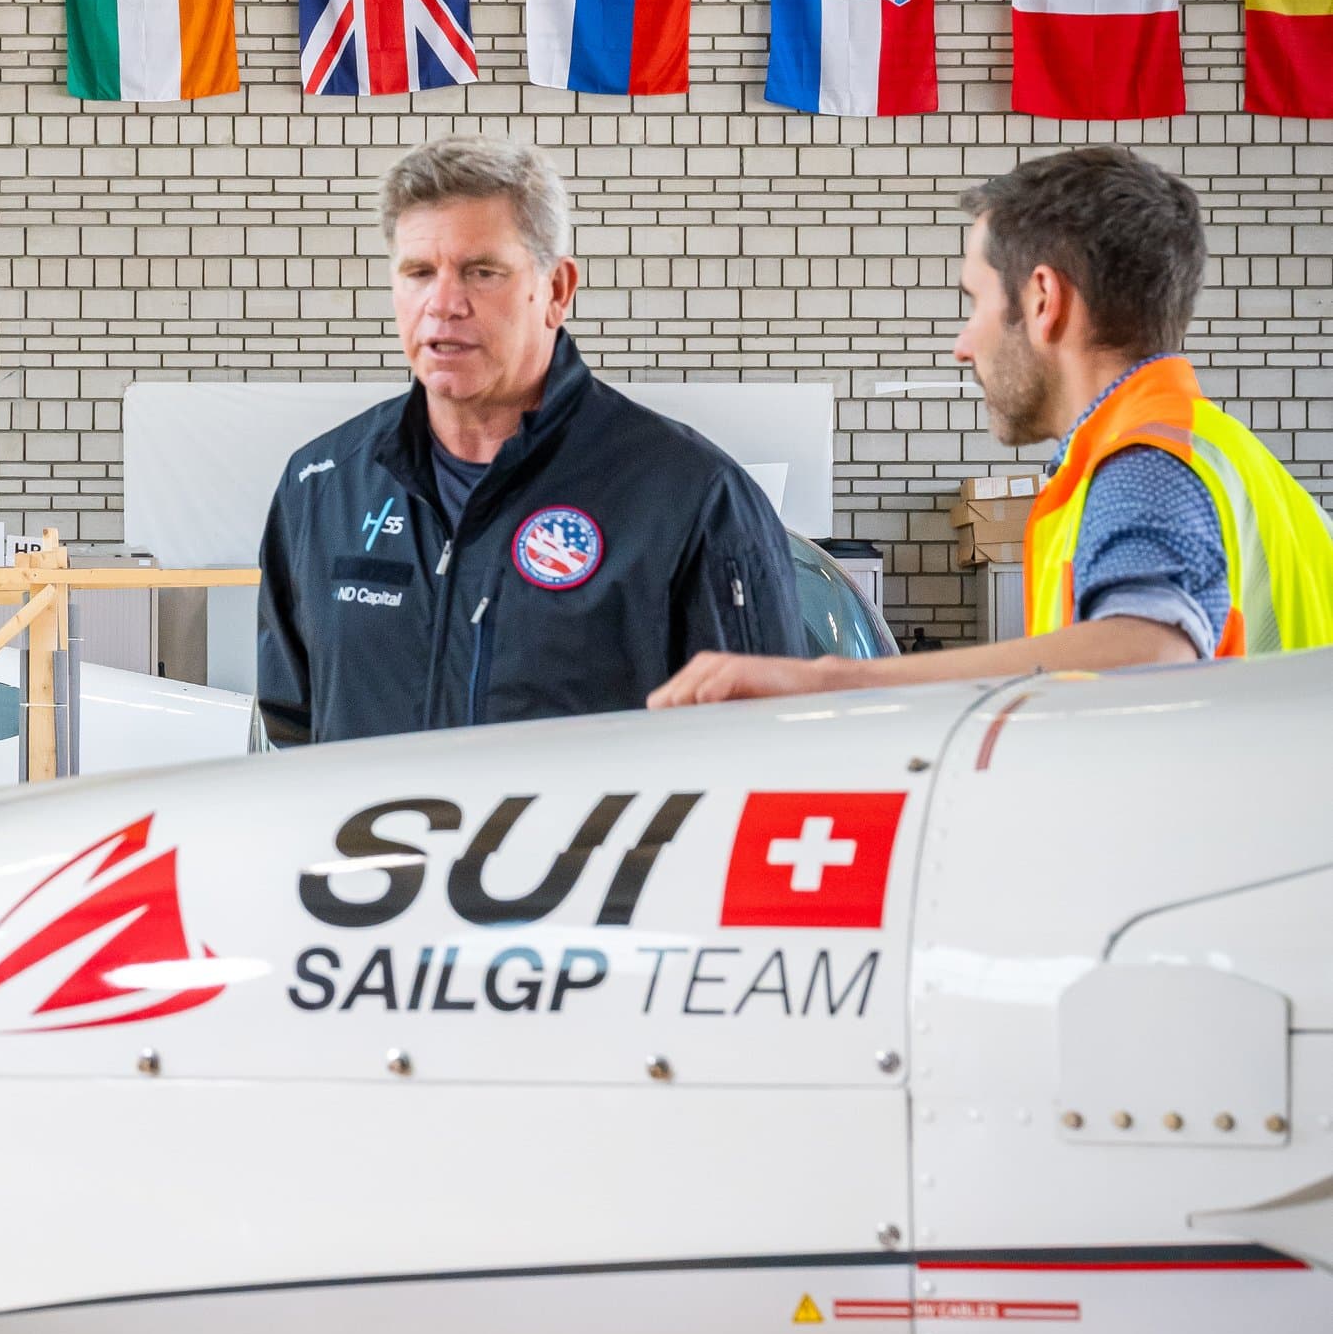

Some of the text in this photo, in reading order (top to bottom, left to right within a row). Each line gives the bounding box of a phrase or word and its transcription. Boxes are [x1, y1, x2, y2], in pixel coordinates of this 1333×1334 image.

[357, 588, 403, 607] Capital
[297, 790, 705, 927] SUI
[288, 945, 880, 1016] SAILGP TEAM
